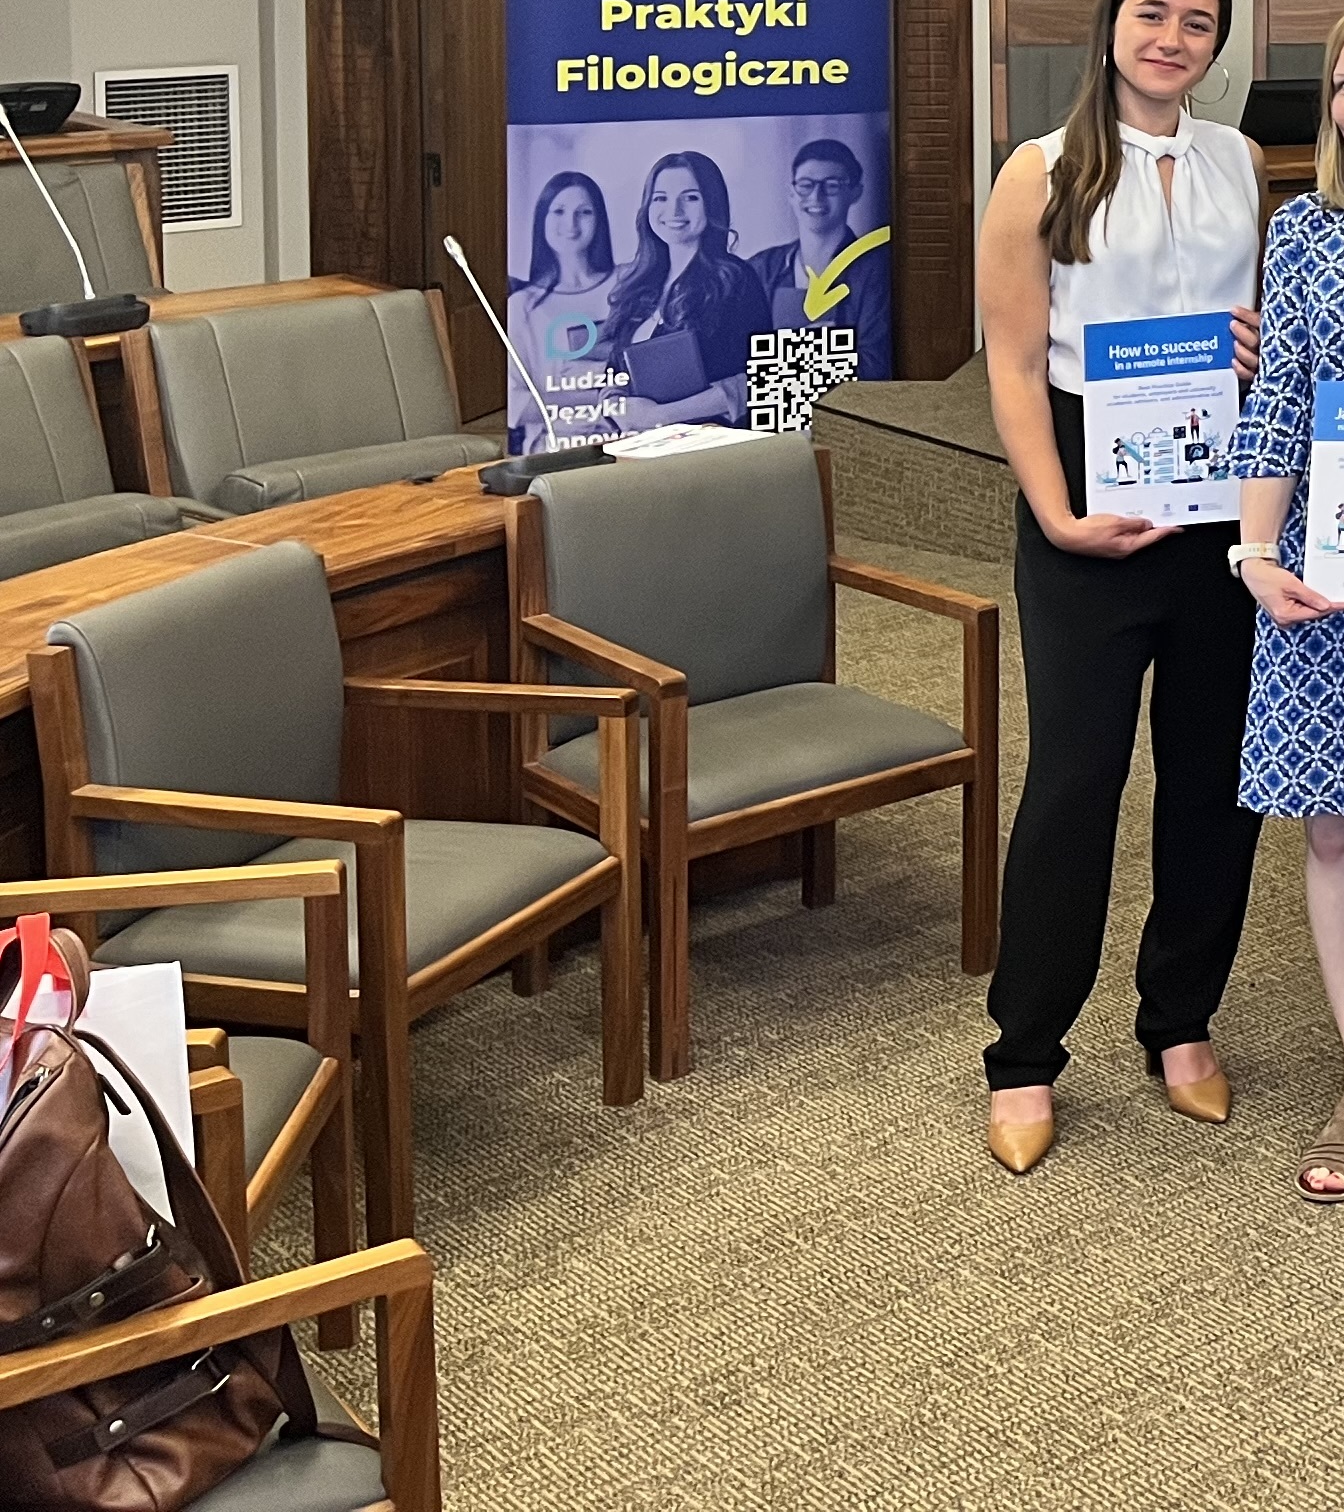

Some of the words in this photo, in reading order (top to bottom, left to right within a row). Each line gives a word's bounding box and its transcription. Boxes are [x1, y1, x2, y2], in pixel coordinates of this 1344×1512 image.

[556, 50, 850, 96] Filologiczne
[1109, 345, 1142, 359] How
[1144, 343, 1159, 356] to
[1161, 335, 1218, 354] succeed
[546, 368, 630, 393] Ludzie
[545, 396, 627, 424] Języki
